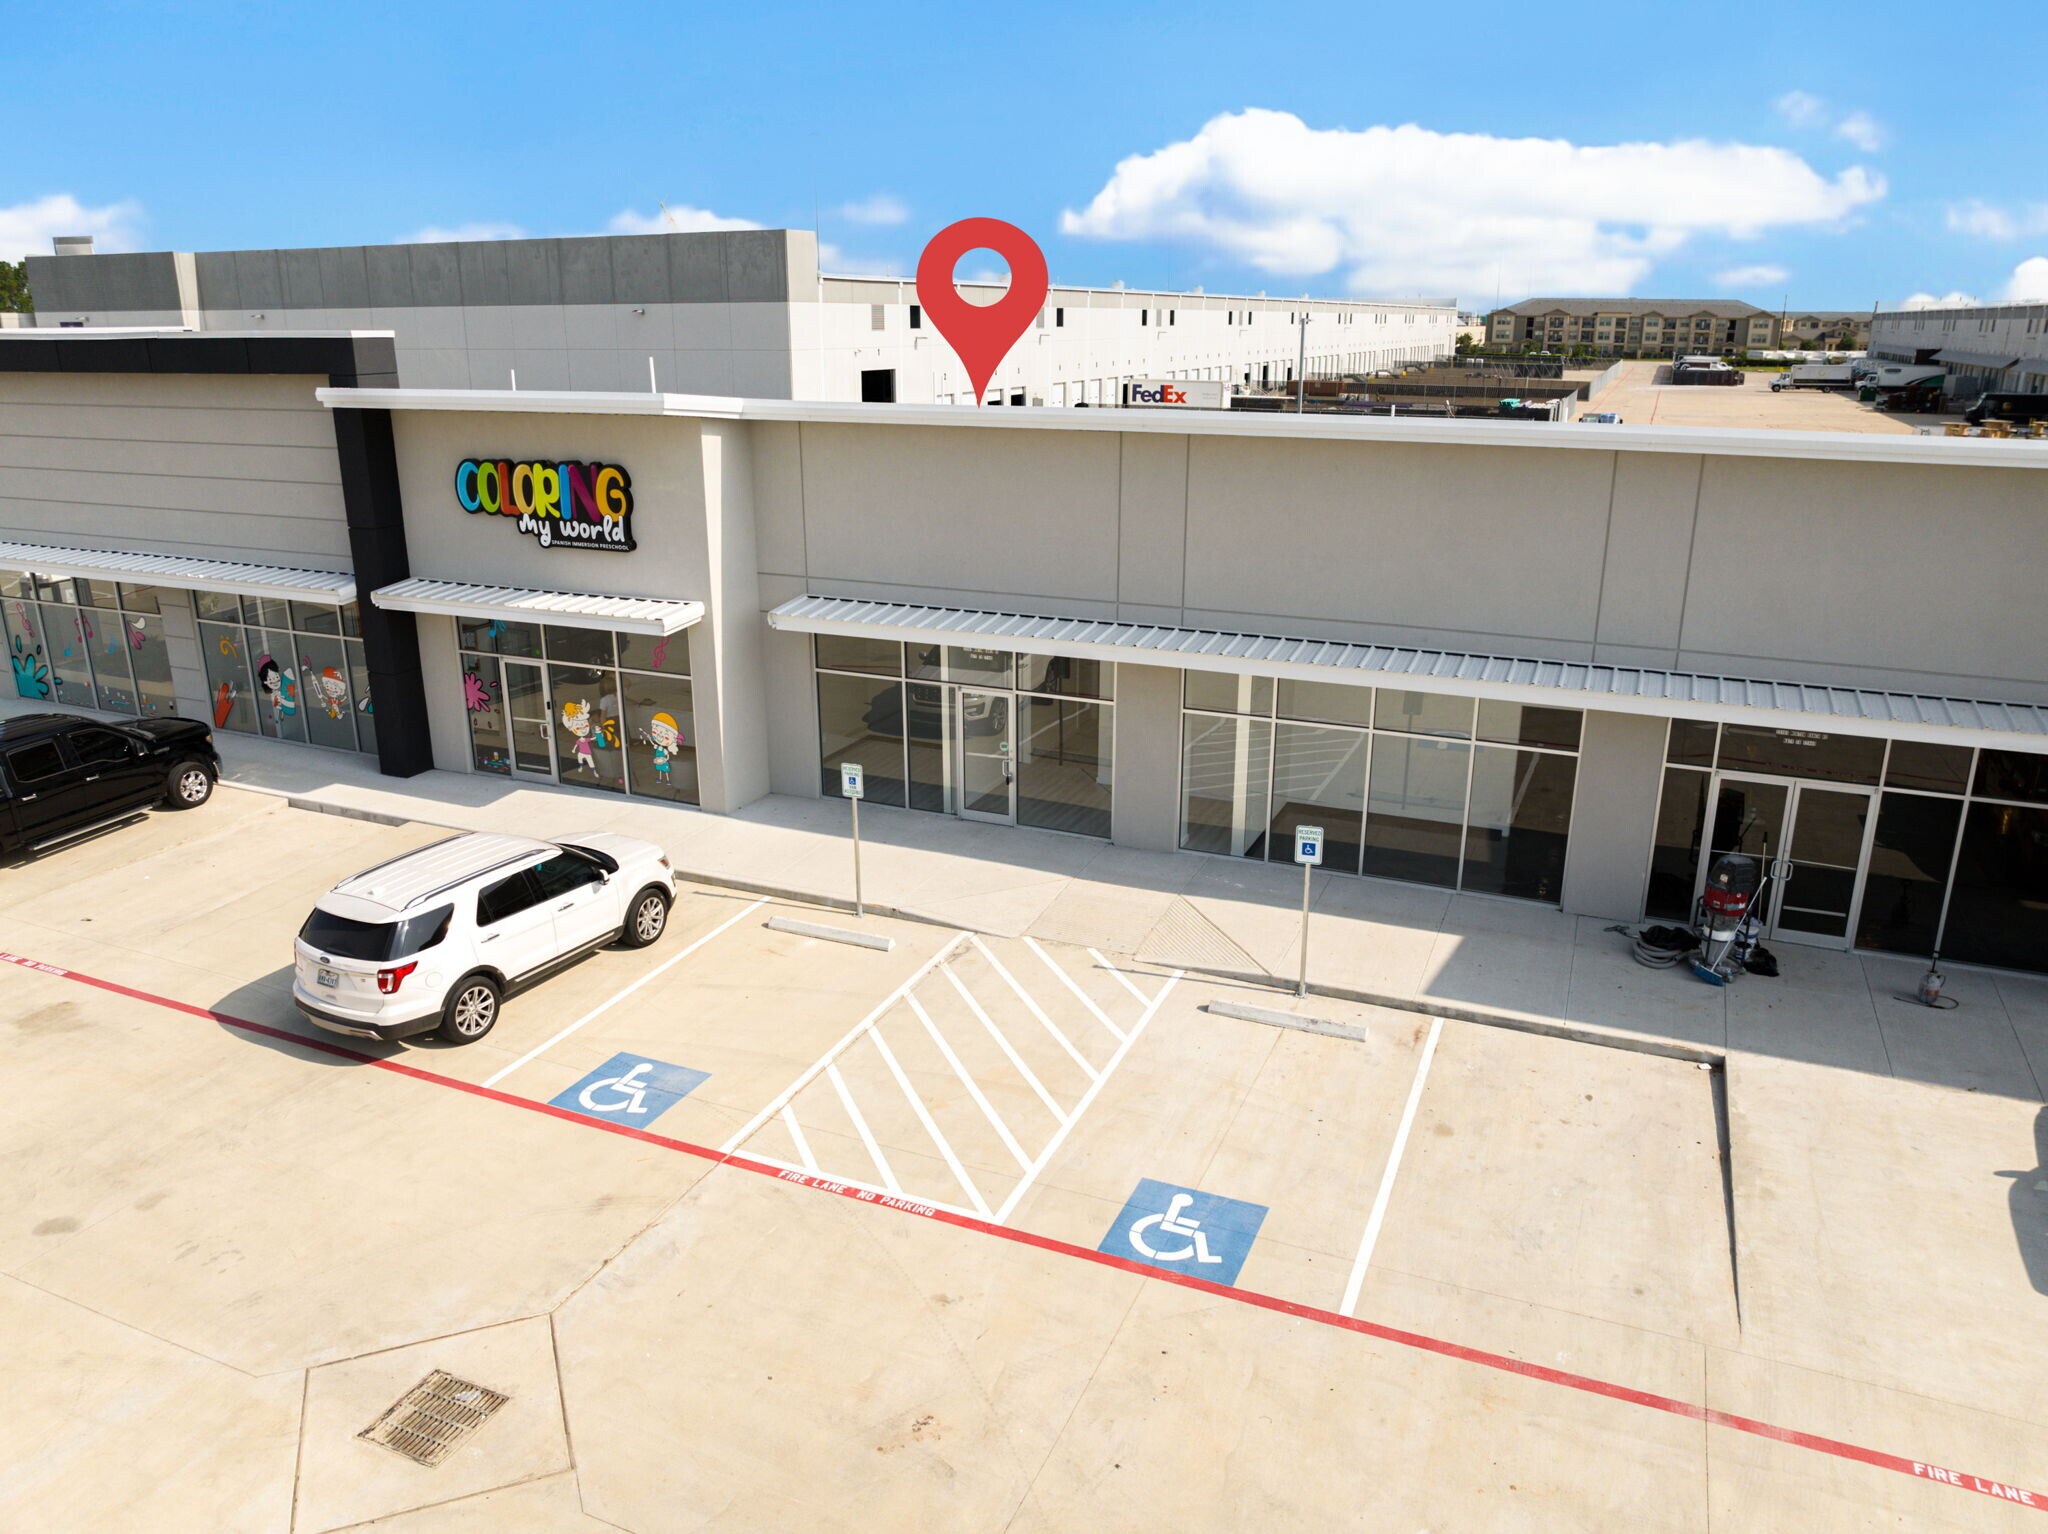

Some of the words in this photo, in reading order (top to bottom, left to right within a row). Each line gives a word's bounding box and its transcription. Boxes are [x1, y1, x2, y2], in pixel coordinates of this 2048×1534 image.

[1132, 384, 1187, 403] FedEx
[457, 461, 627, 522] COLORING
[559, 514, 626, 542] world
[599, 543, 630, 551] PRESCHOOL
[777, 1170, 810, 1184] FIRE
[811, 1179, 848, 1194] LANE
[856, 1190, 876, 1201] NO
[880, 1196, 937, 1217] PARKING
[1912, 1462, 1964, 1486] FIRE
[1974, 1477, 2036, 1506] LANE
